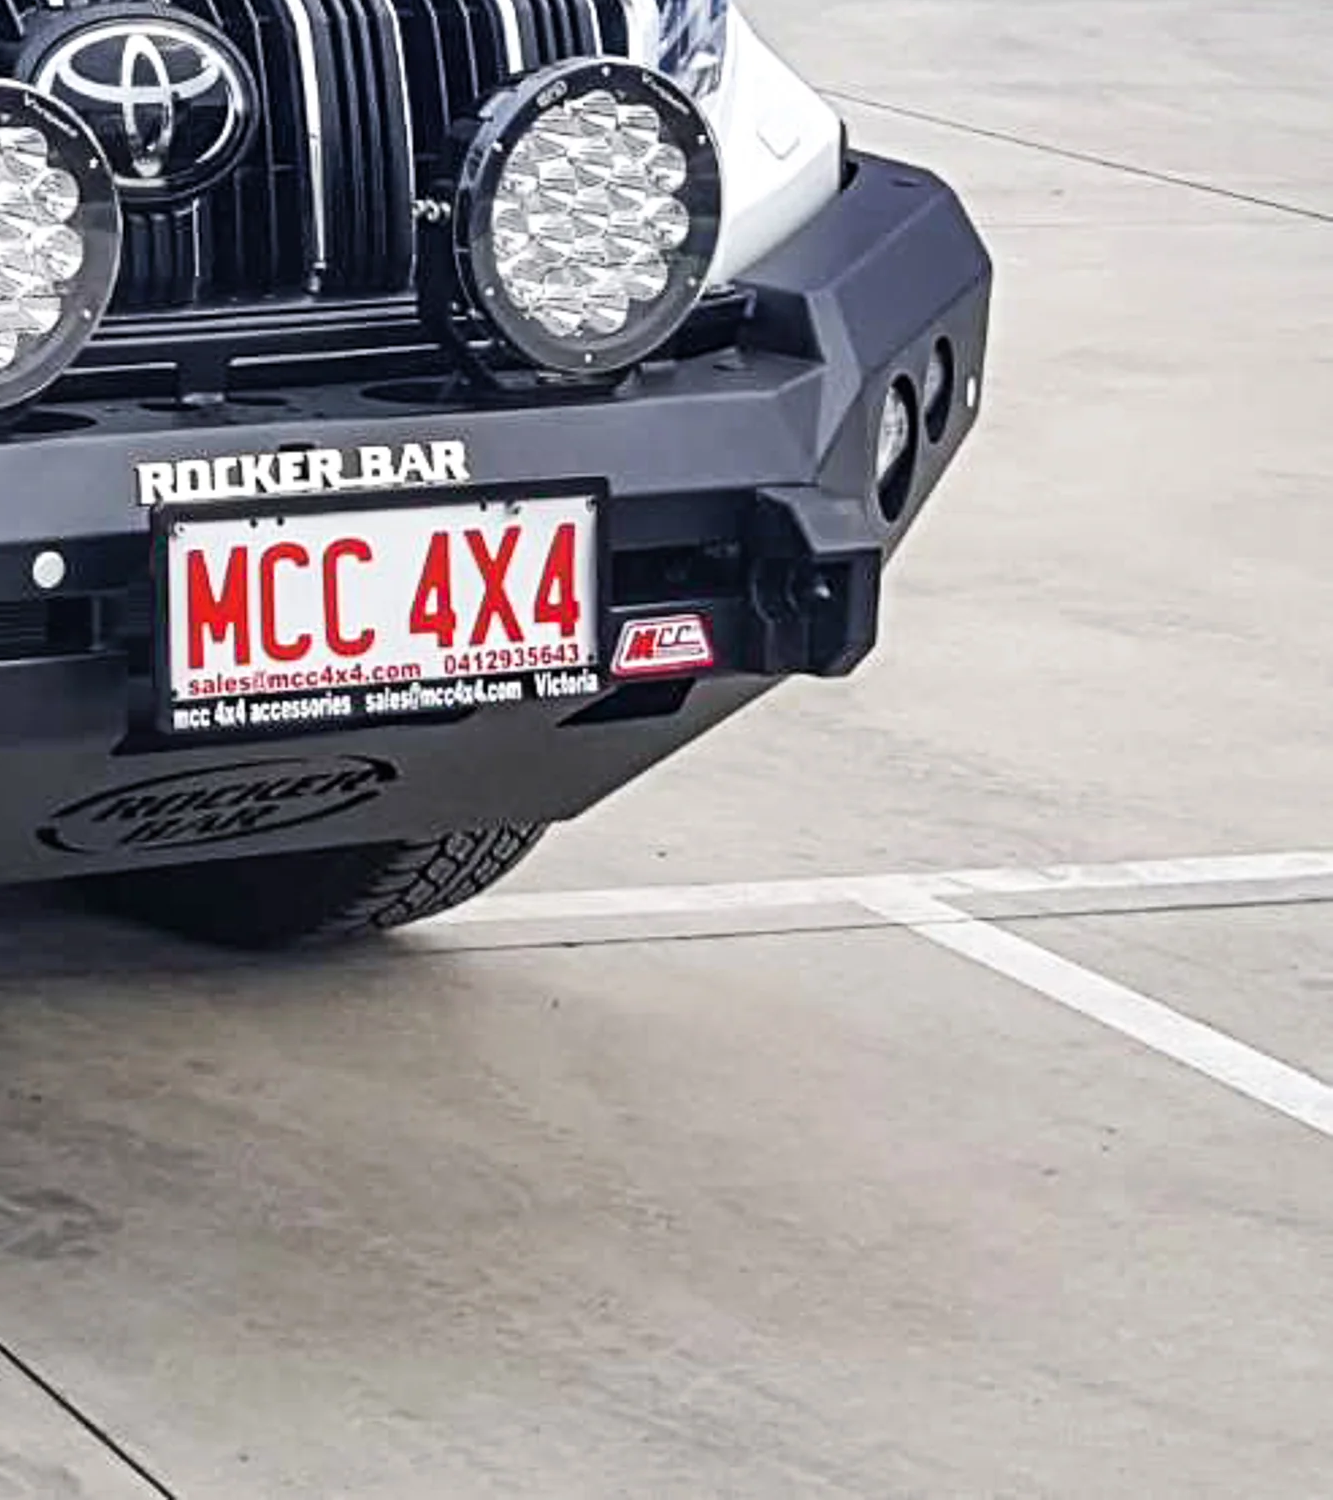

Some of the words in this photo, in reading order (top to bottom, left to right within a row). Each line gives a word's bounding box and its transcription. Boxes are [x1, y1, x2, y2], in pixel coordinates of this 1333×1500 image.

[137, 450, 347, 504] ROCKER
[359, 440, 469, 485] BAR
[187, 538, 375, 669] MCC
[409, 523, 580, 647] 4X4
[173, 707, 210, 730] mcc
[214, 699, 246, 725] 4x4
[249, 691, 351, 723] accessories
[535, 669, 598, 697] Victoria
